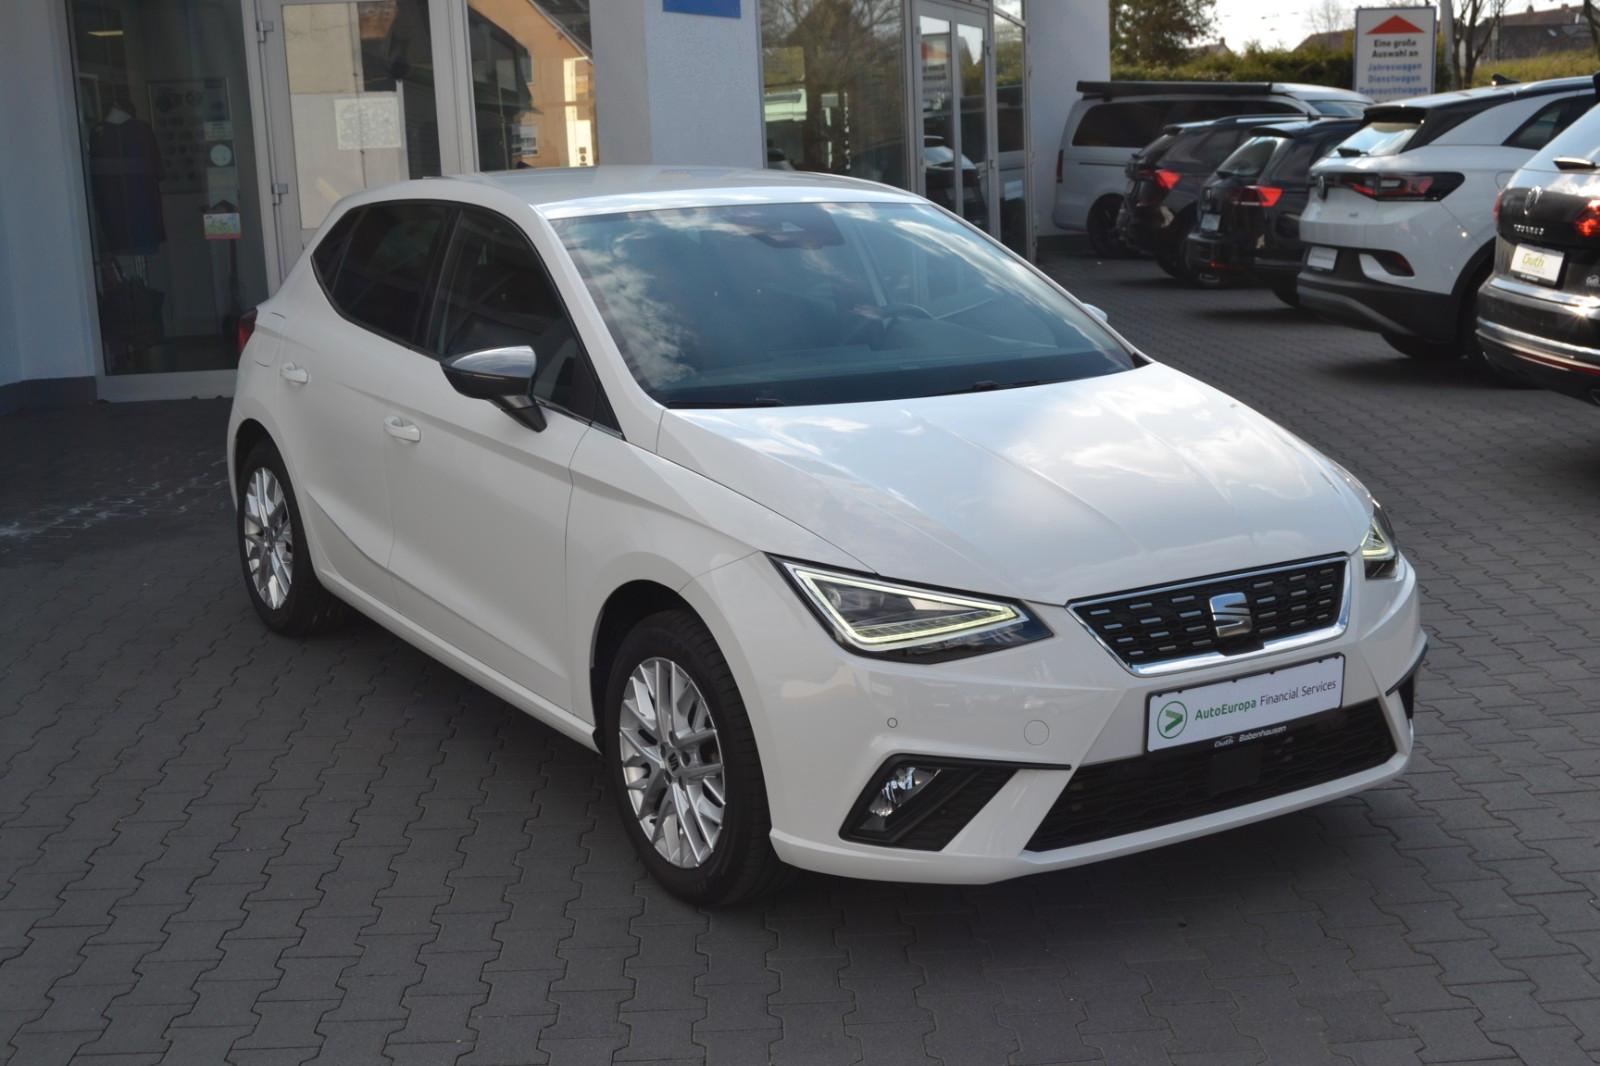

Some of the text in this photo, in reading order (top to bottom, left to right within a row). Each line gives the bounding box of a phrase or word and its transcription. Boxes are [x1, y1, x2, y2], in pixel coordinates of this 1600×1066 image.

[1374, 39, 1391, 48] Eine
[1371, 49, 1418, 58] Auswahl an
[1368, 63, 1422, 73] Jahreswagen
[1367, 74, 1421, 84] Dienstwagen
[1194, 679, 1337, 721] AutoEuropa Financial Services
